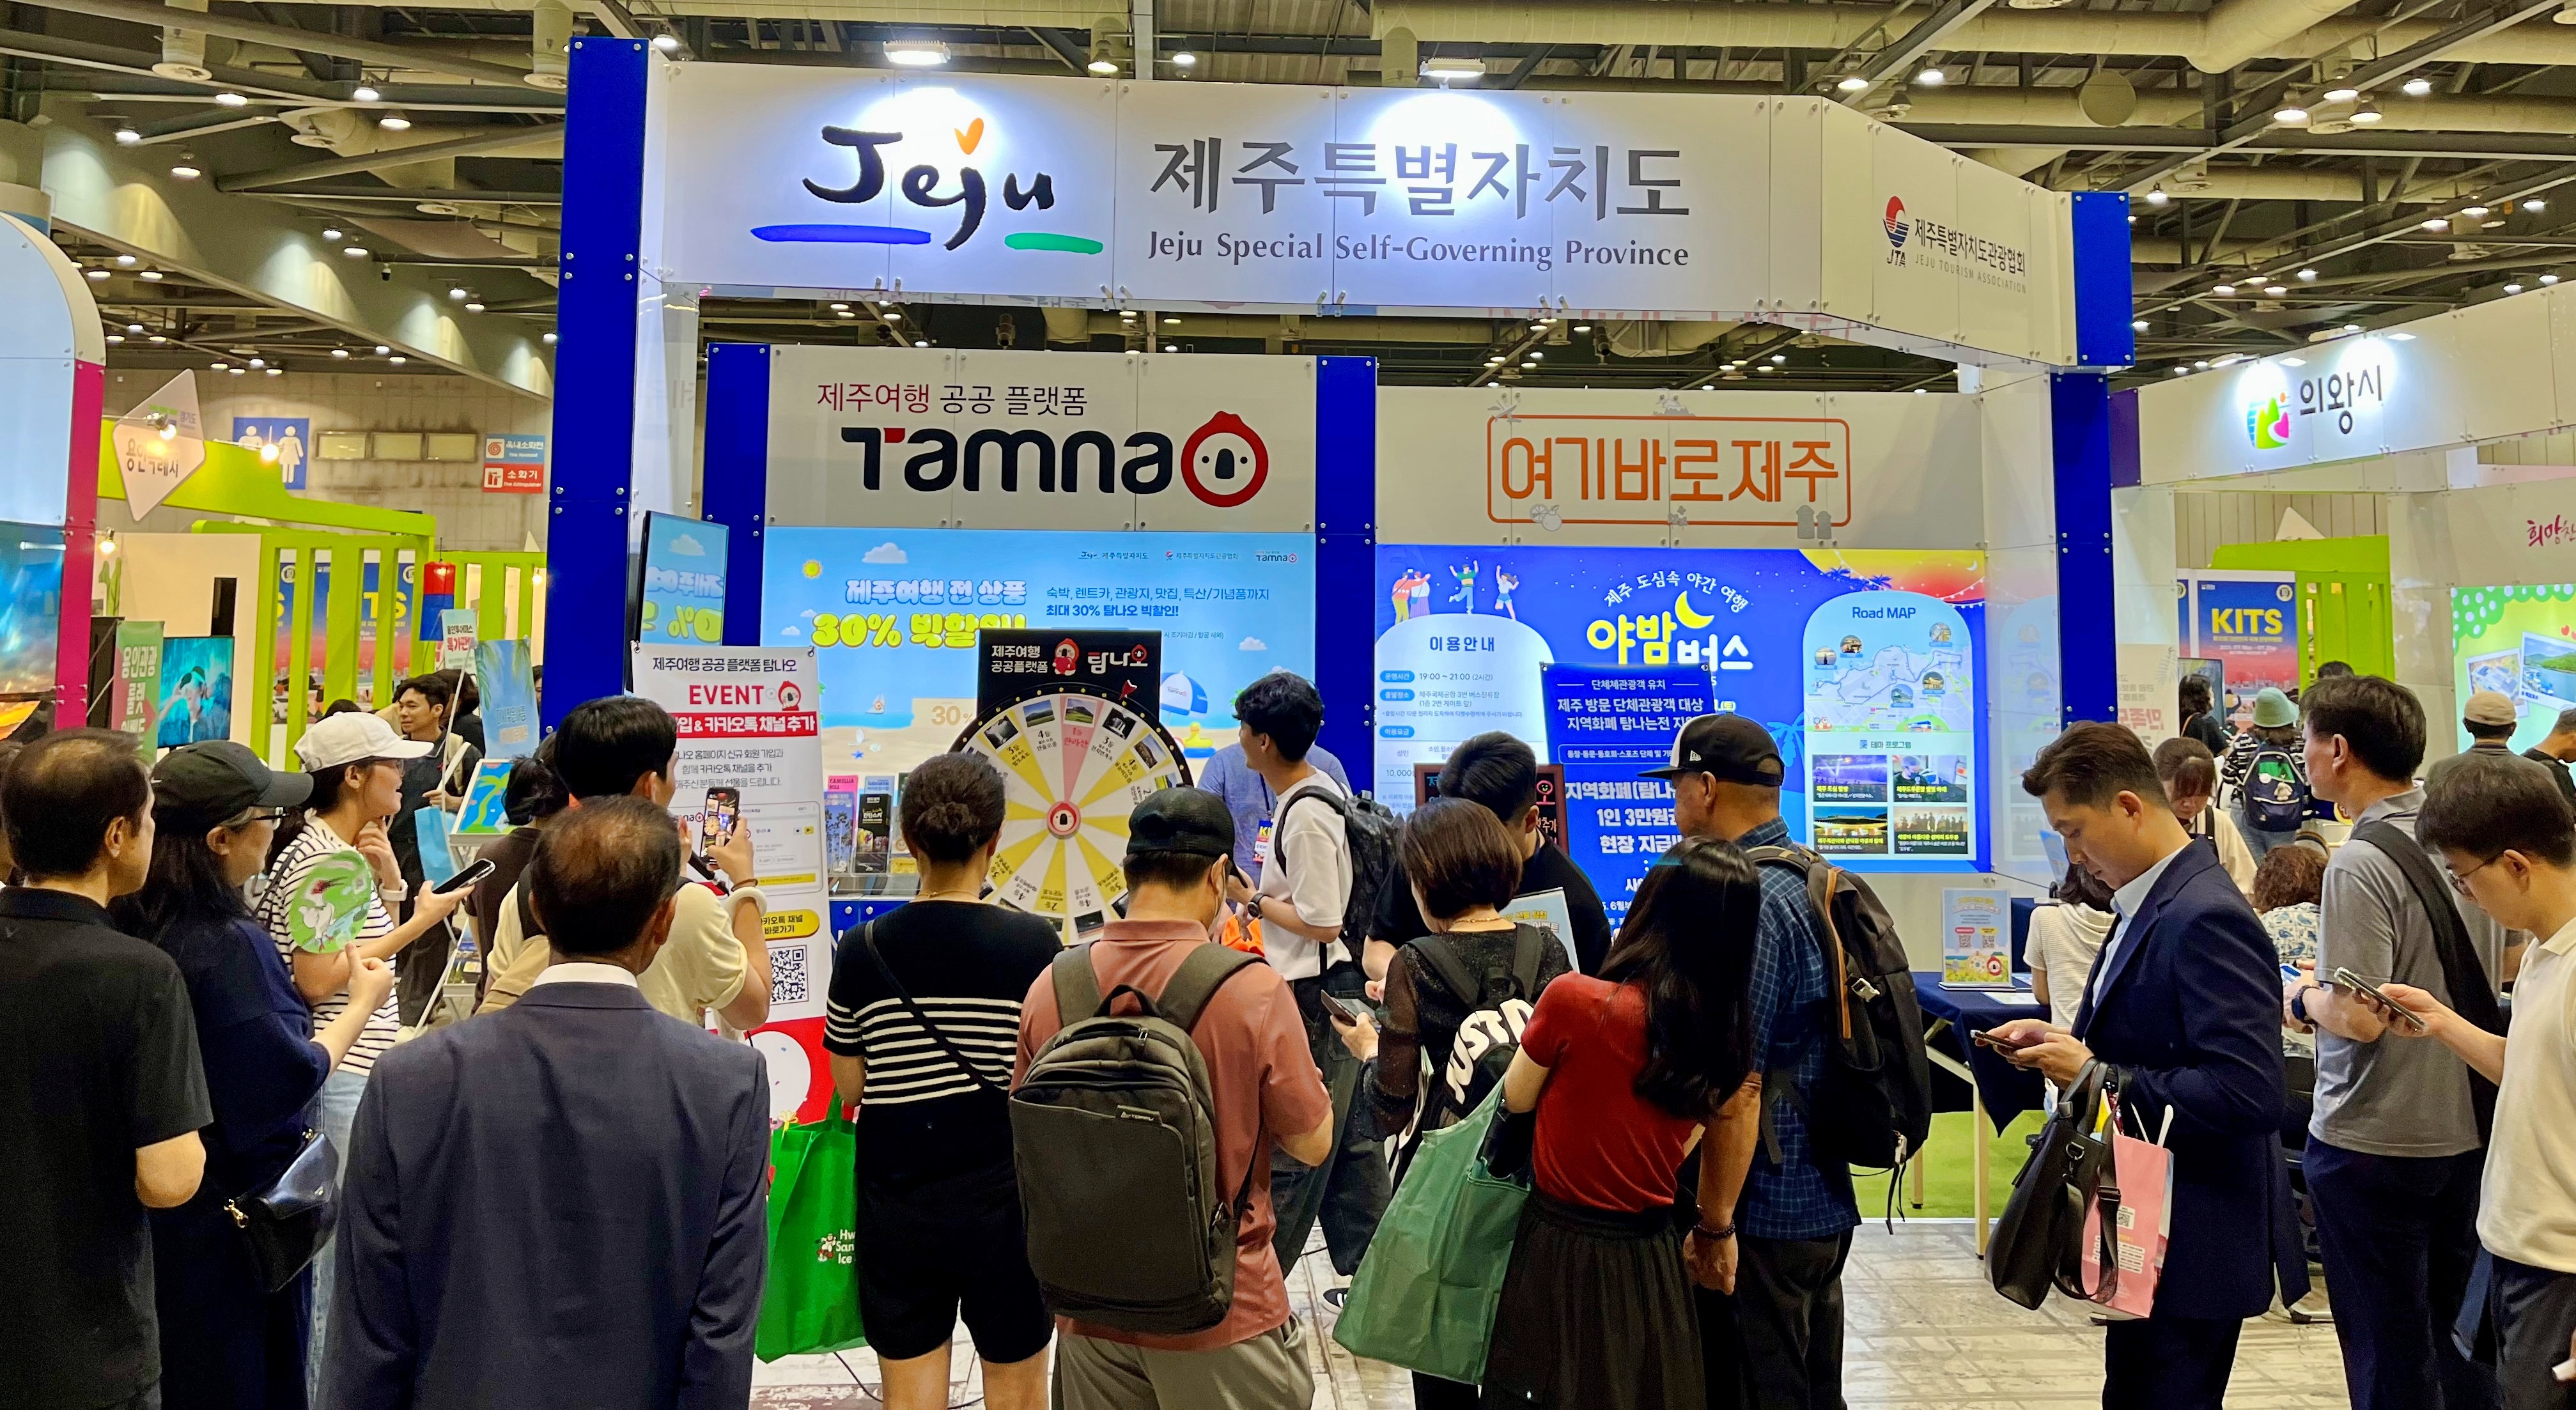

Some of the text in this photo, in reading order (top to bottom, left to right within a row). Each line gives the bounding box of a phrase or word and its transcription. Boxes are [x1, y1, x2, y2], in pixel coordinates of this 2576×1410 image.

[802, 118, 1054, 251] Jeju
[1150, 136, 1689, 221] 제주특별자치도
[1149, 231, 1689, 272] Jeju Special Self-Governing Province
[1914, 217, 2026, 277] 제주특별자치도관광협회
[1886, 249, 1906, 268] JTA
[1915, 253, 2027, 295] JEJU TOURISM ASSOCIATION
[817, 382, 1089, 416] 제주여행 공공 플랫폼
[2299, 364, 2383, 435] 의왕시
[507, 470, 538, 480] 소화기
[1501, 437, 1839, 503] 여기바로제주
[1101, 552, 1149, 561] 제주특별자치도
[845, 578, 1027, 605] 제주여행 전 상품
[1046, 587, 1269, 601] 숙박, 렌트카, 관광지, 맛집, 특산/기념품까지
[1603, 569, 1749, 614] 제주 도심속 야간 여행
[1046, 605, 1179, 617] 최대 30% 탐나오 빅할인!
[1852, 606, 1916, 619] Road MAP
[2211, 608, 2283, 635] KITS
[811, 612, 902, 649] 30%
[447, 637, 476, 653] 특가판
[1429, 635, 1495, 653] 이용안내
[1586, 610, 1754, 672] 야밤버스
[991, 645, 1041, 658] 제주여행
[1087, 644, 1149, 675] 탐나오
[121, 645, 158, 679] 용인관광
[653, 656, 797, 672] 제주여행 공공 플랫폼 탐나오
[991, 660, 1048, 674] 공공플랫폼
[1419, 672, 1441, 681] 19:00
[1449, 672, 1471, 681] 21:00
[1591, 679, 1666, 690] 단체체관광객 유치
[688, 684, 764, 706] EVENT
[1557, 697, 1704, 713] 제주 방문 단체관광객 대상
[676, 715, 816, 733] 입 & 카카오톡 채널 추가
[1567, 716, 1618, 731] 지역화폐
[1619, 715, 1670, 731] 탐나는전
[1870, 741, 1912, 749] 테마 프로그램
[677, 748, 784, 760] 나오 홈페이지 신규 회원 가입과
[1640, 749, 1654, 759] 단체
[682, 763, 773, 775] 함께 카카오톡 채널을 추가
[1386, 769, 1415, 777] 10,000
[700, 779, 724, 789] 분들께
[725, 778, 749, 787] 선물을
[749, 777, 782, 787] 드립니다.
[1596, 808, 1621, 827] 1인
[1599, 834, 1634, 854] 현장
[787, 913, 803, 924] 채널
[764, 923, 795, 935] 바로가기
[835, 1241, 855, 1253] San
[838, 1253, 853, 1264] Ice
